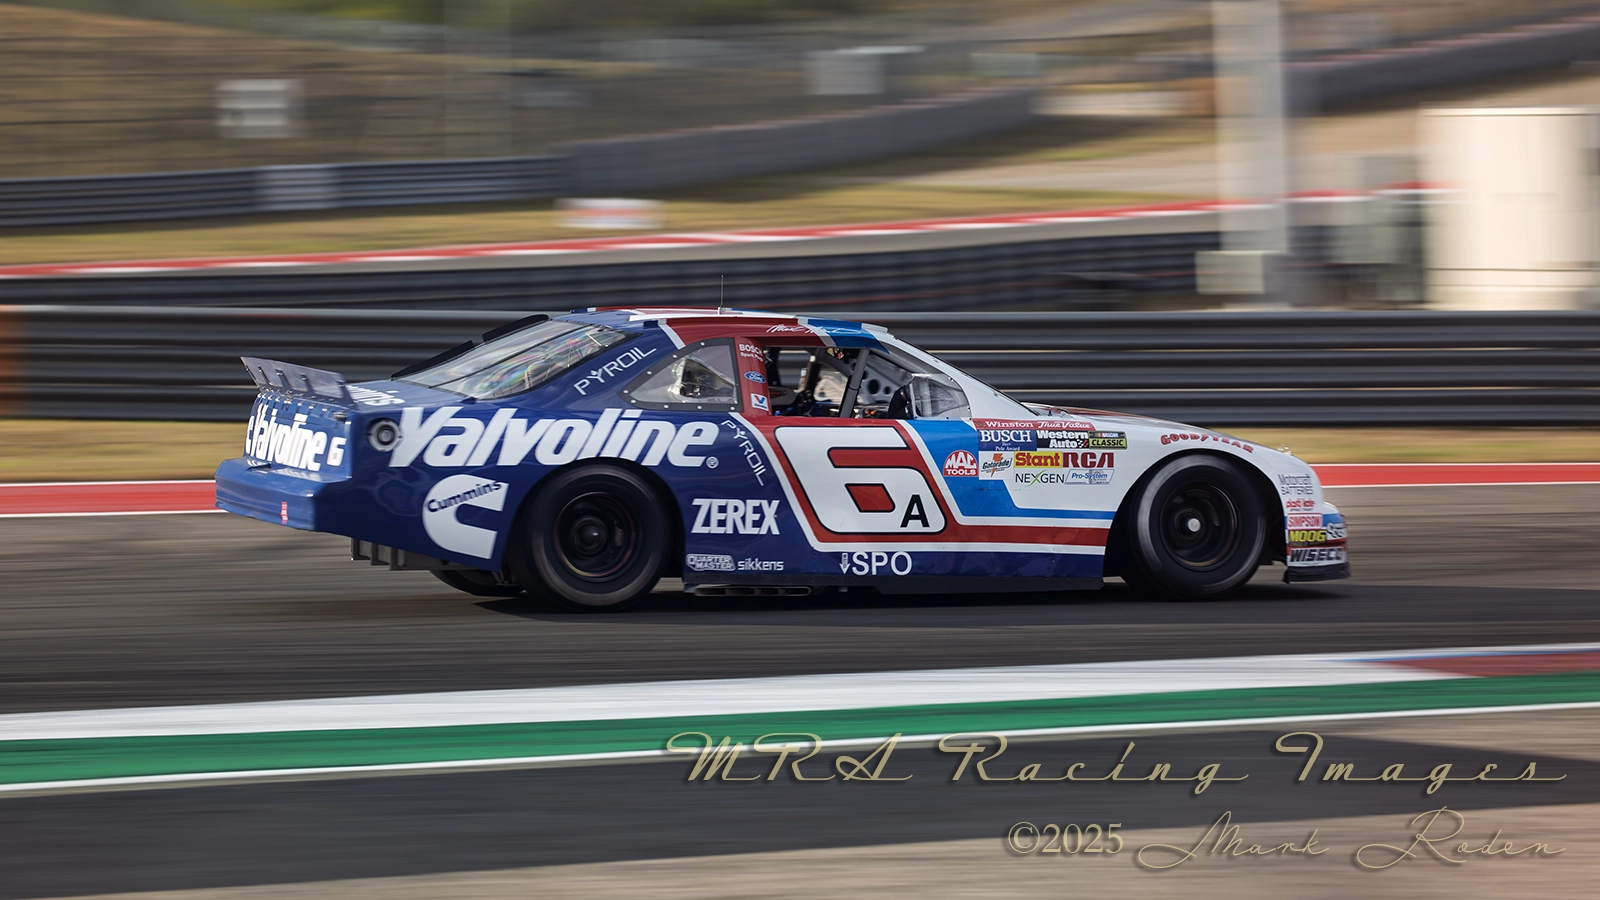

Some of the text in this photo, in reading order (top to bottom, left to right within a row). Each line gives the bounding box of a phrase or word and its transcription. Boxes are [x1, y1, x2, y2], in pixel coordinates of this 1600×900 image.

[573, 347, 657, 396] PYROIL
[250, 403, 328, 472] Valvoline
[326, 436, 347, 467] 6
[388, 406, 719, 467] Valvoline
[980, 430, 1032, 442] BUSCH
[1036, 430, 1088, 439] Western
[1049, 439, 1077, 448] Auto
[720, 420, 767, 487] PYROIL
[945, 452, 977, 469] MAC
[1015, 453, 1060, 467] Stant
[1063, 452, 1114, 468] RCA
[982, 457, 1013, 470] Gatorade
[774, 426, 947, 535] 6
[426, 481, 502, 513] Cummins
[691, 498, 780, 535] ZEREX
[900, 495, 930, 527] A
[1288, 516, 1320, 527] SIMPSON
[1289, 530, 1327, 542] MOOG
[737, 558, 784, 570] sikkens
[852, 551, 912, 576] SPO
